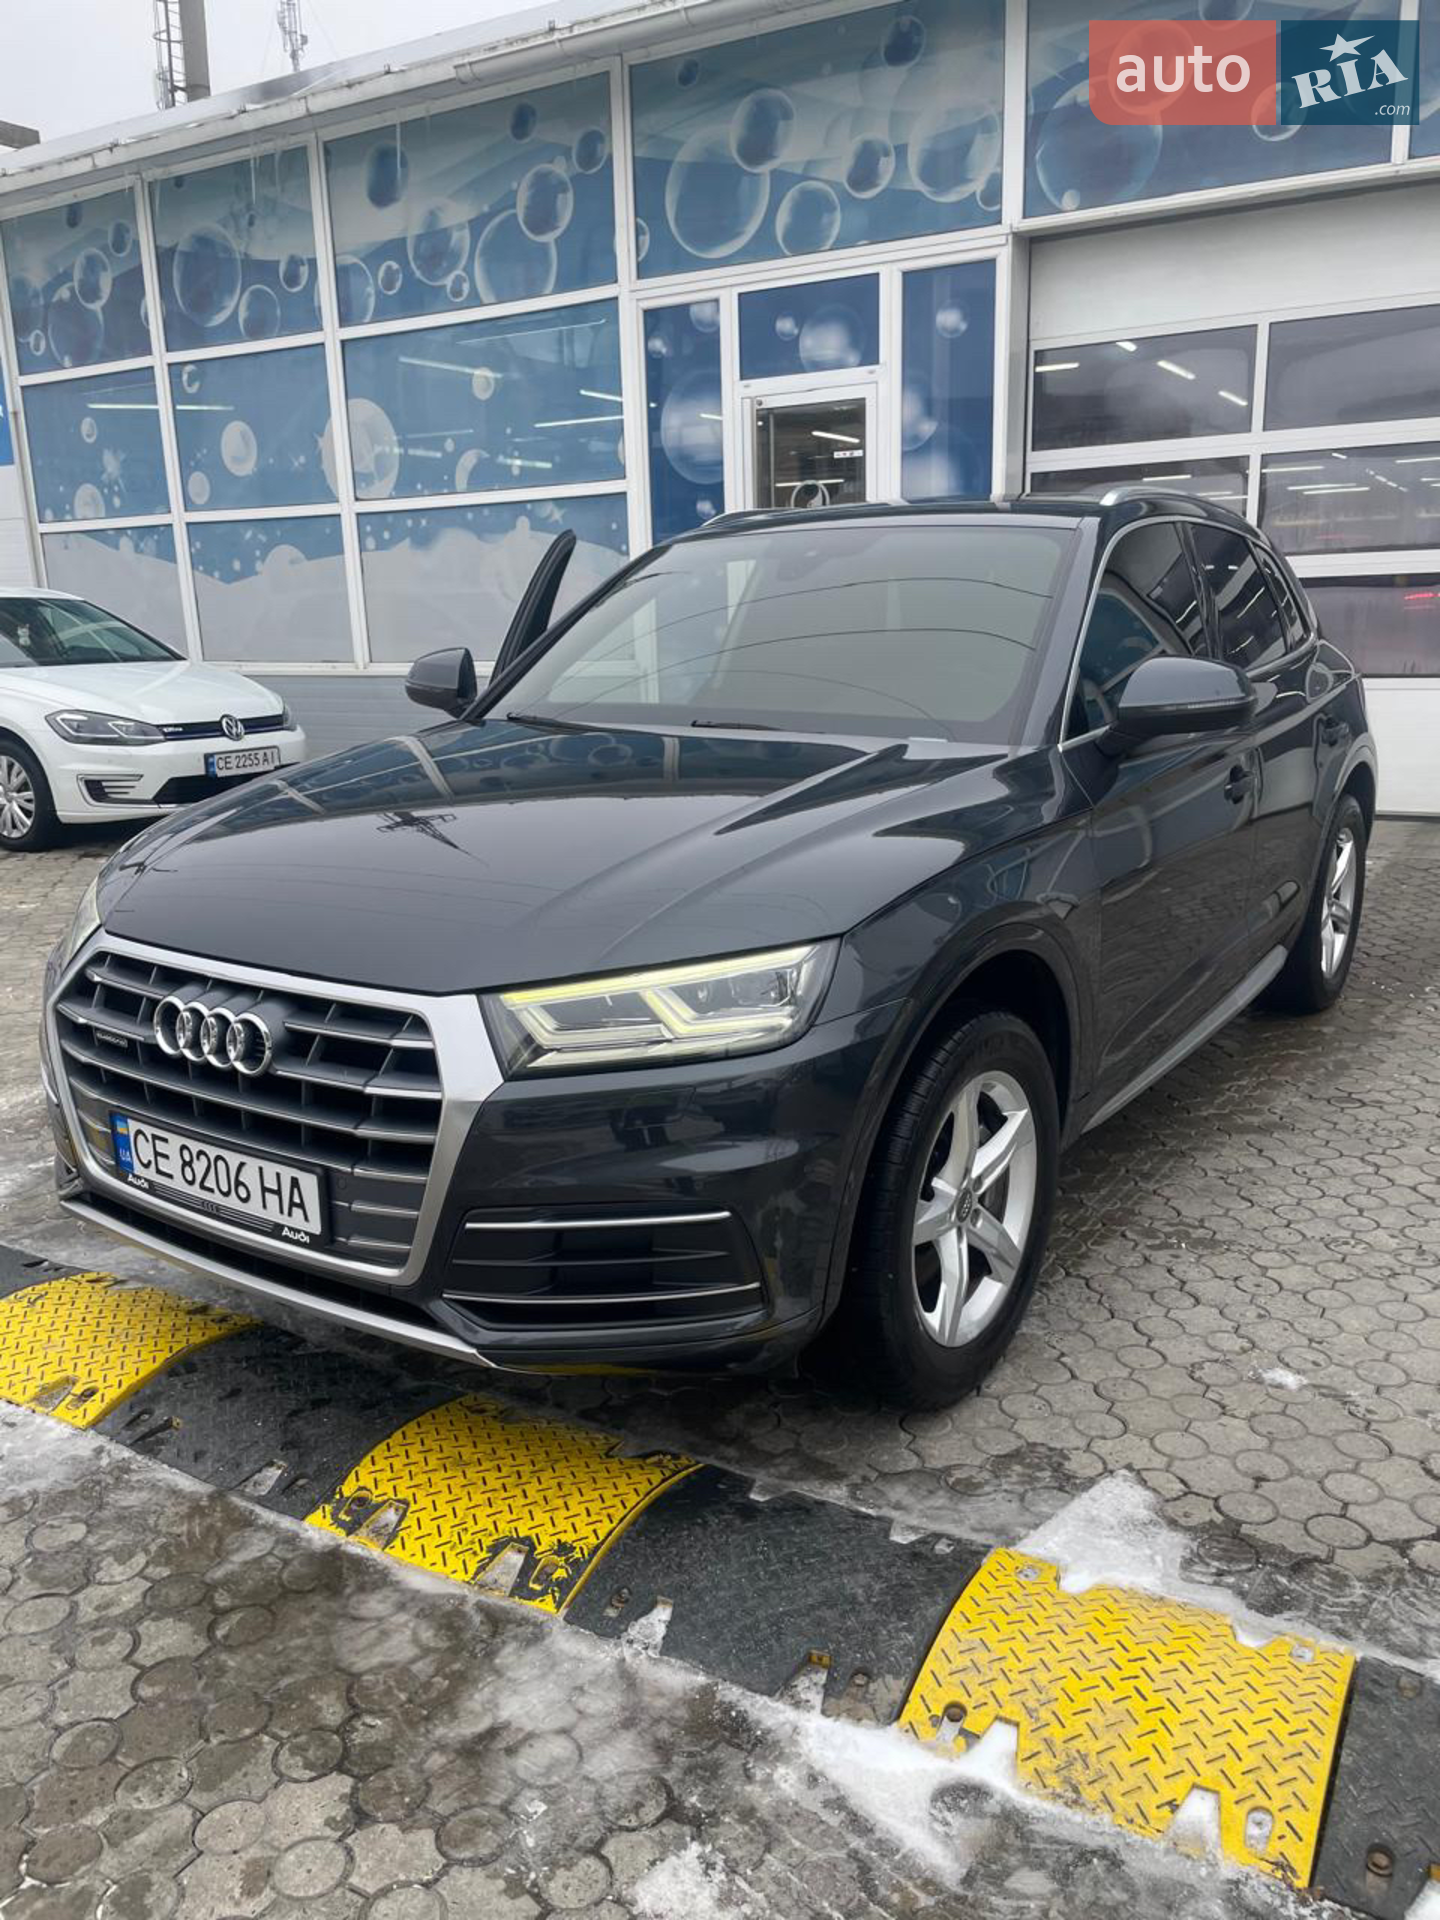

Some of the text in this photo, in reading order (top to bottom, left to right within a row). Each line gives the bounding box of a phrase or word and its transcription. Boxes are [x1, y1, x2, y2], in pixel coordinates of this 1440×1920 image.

[216, 751, 275, 770] CE 2255 AI
[128, 1173, 149, 1189] Audi
[133, 1128, 310, 1223] CE 8206 HA
[281, 1226, 310, 1244] Audi
